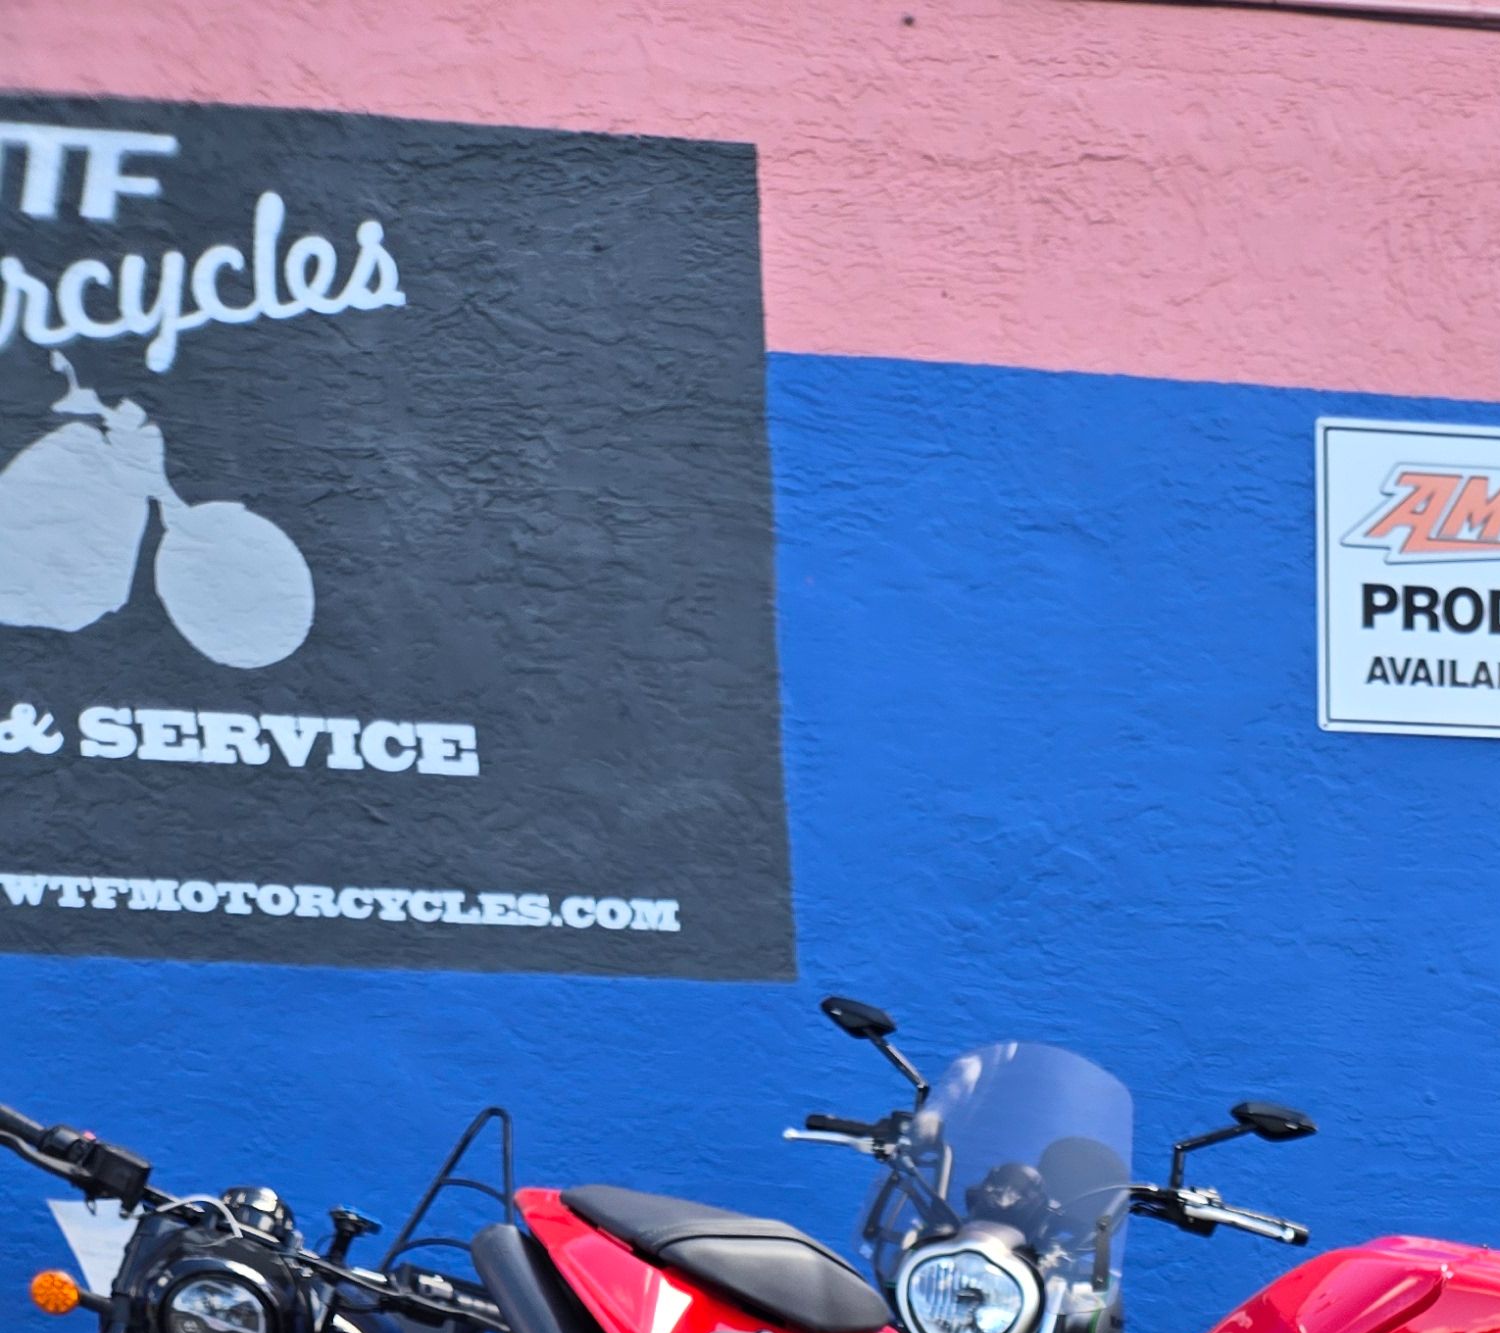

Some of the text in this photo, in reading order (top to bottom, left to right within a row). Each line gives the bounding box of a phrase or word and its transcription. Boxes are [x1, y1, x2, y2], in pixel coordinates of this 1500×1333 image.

[0, 122, 179, 220] TF
[0, 702, 481, 778] & SERVICE
[0, 872, 682, 933] WTFMOTORCYCLES.COM
